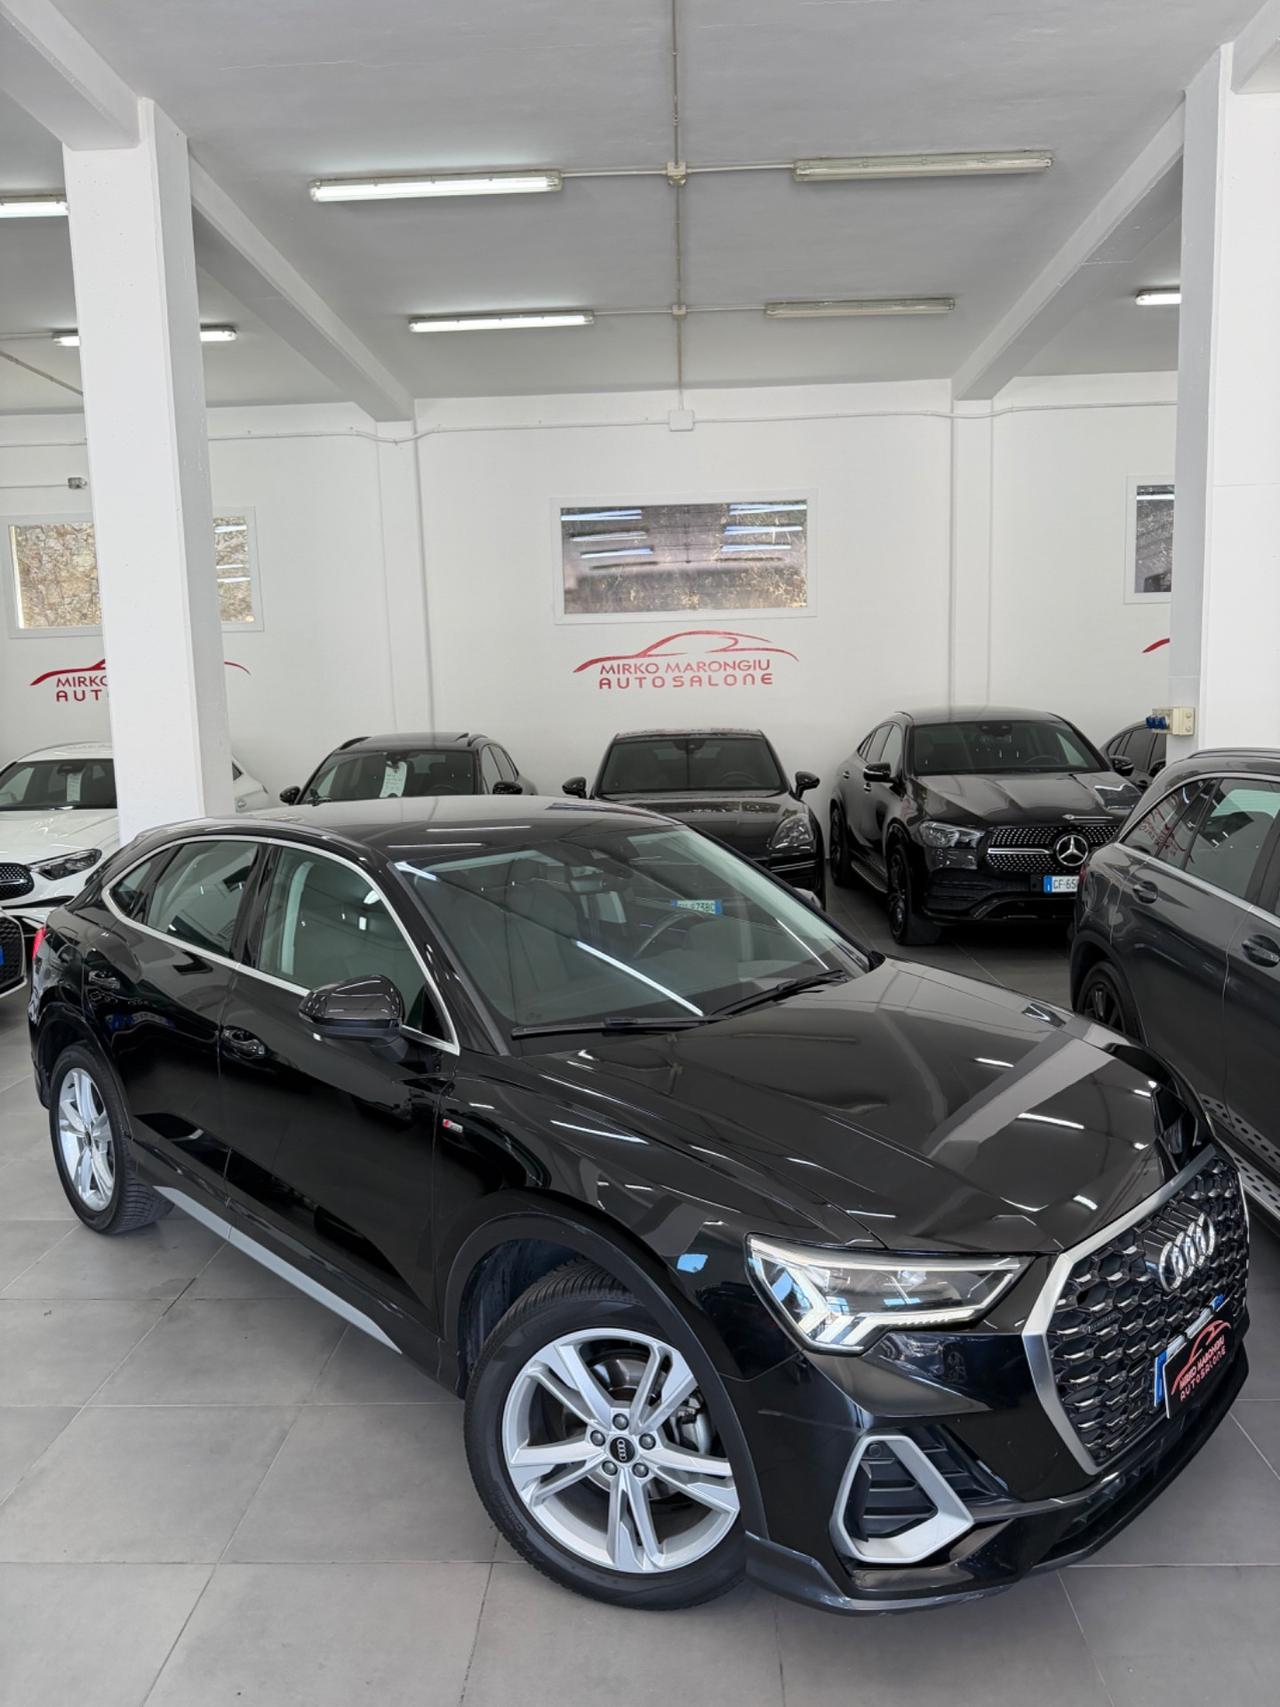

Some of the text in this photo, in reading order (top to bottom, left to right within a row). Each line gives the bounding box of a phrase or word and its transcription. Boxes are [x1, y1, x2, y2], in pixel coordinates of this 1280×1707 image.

[600, 659, 770, 675] MIRKO MARONGIU
[599, 673, 773, 690] AUTOSALONE
